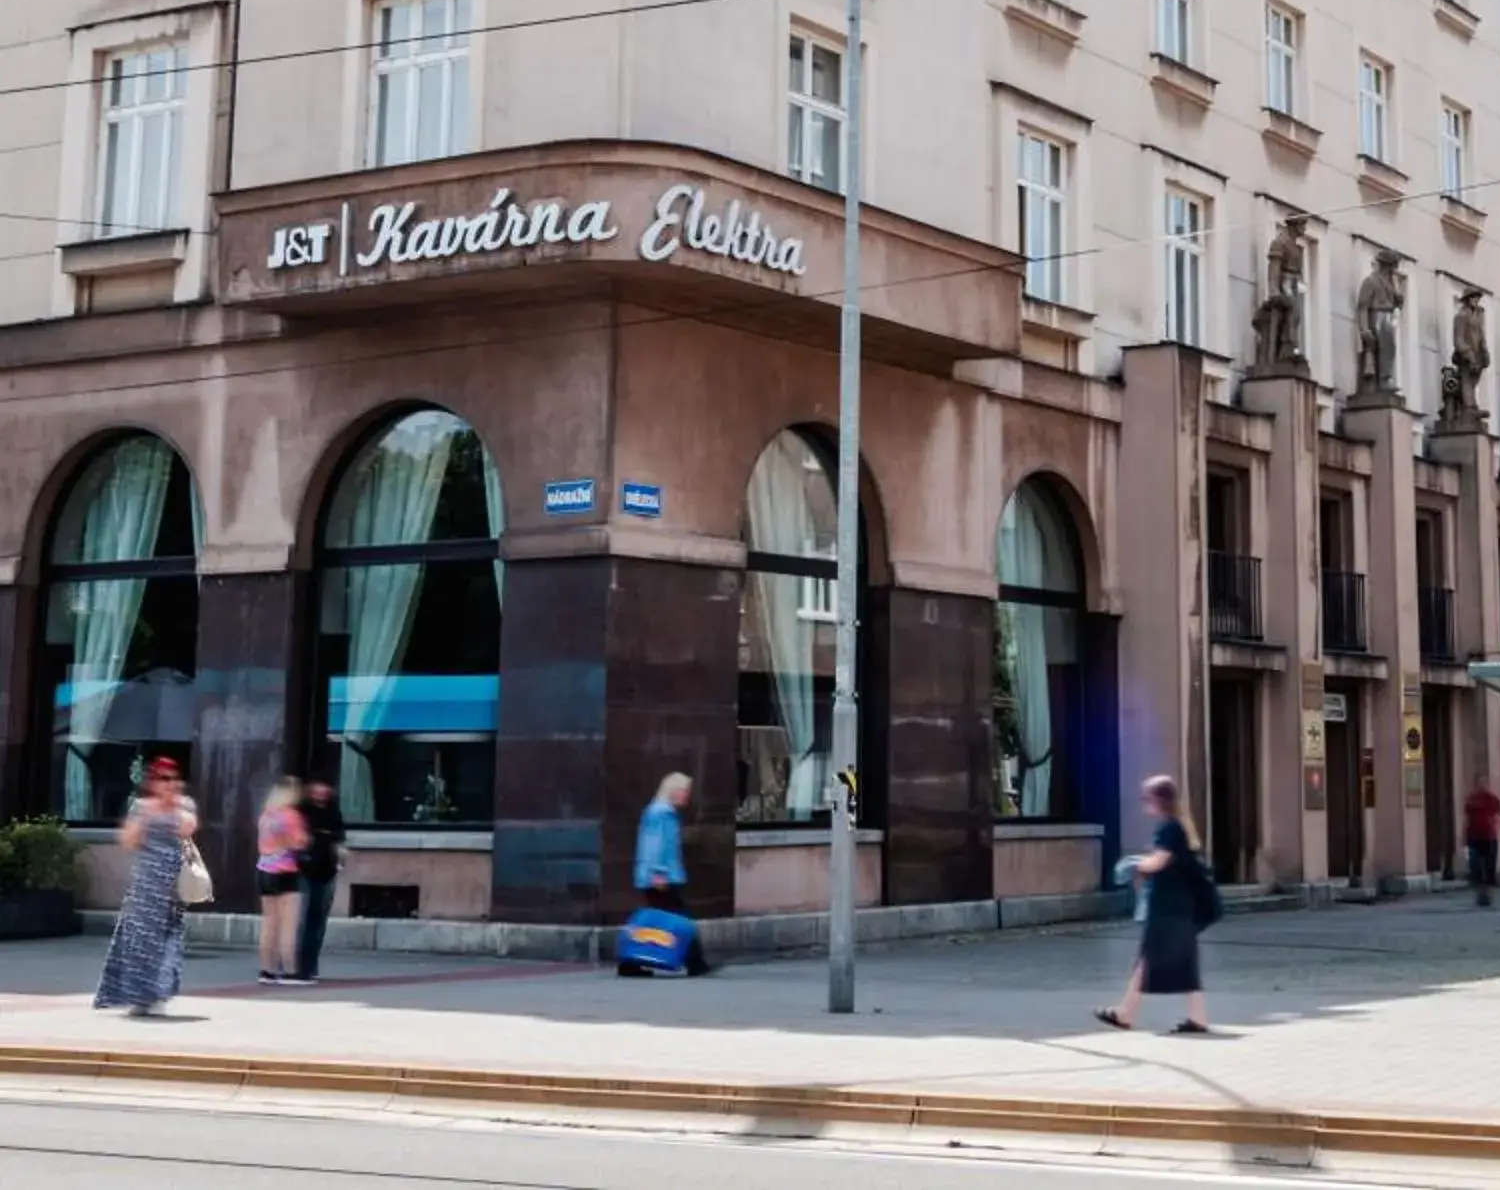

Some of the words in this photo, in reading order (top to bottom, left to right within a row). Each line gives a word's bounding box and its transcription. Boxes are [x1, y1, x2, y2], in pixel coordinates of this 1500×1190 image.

[267, 224, 330, 269] J&T
[357, 187, 618, 267] Kavárna
[640, 184, 806, 275] Elektra
